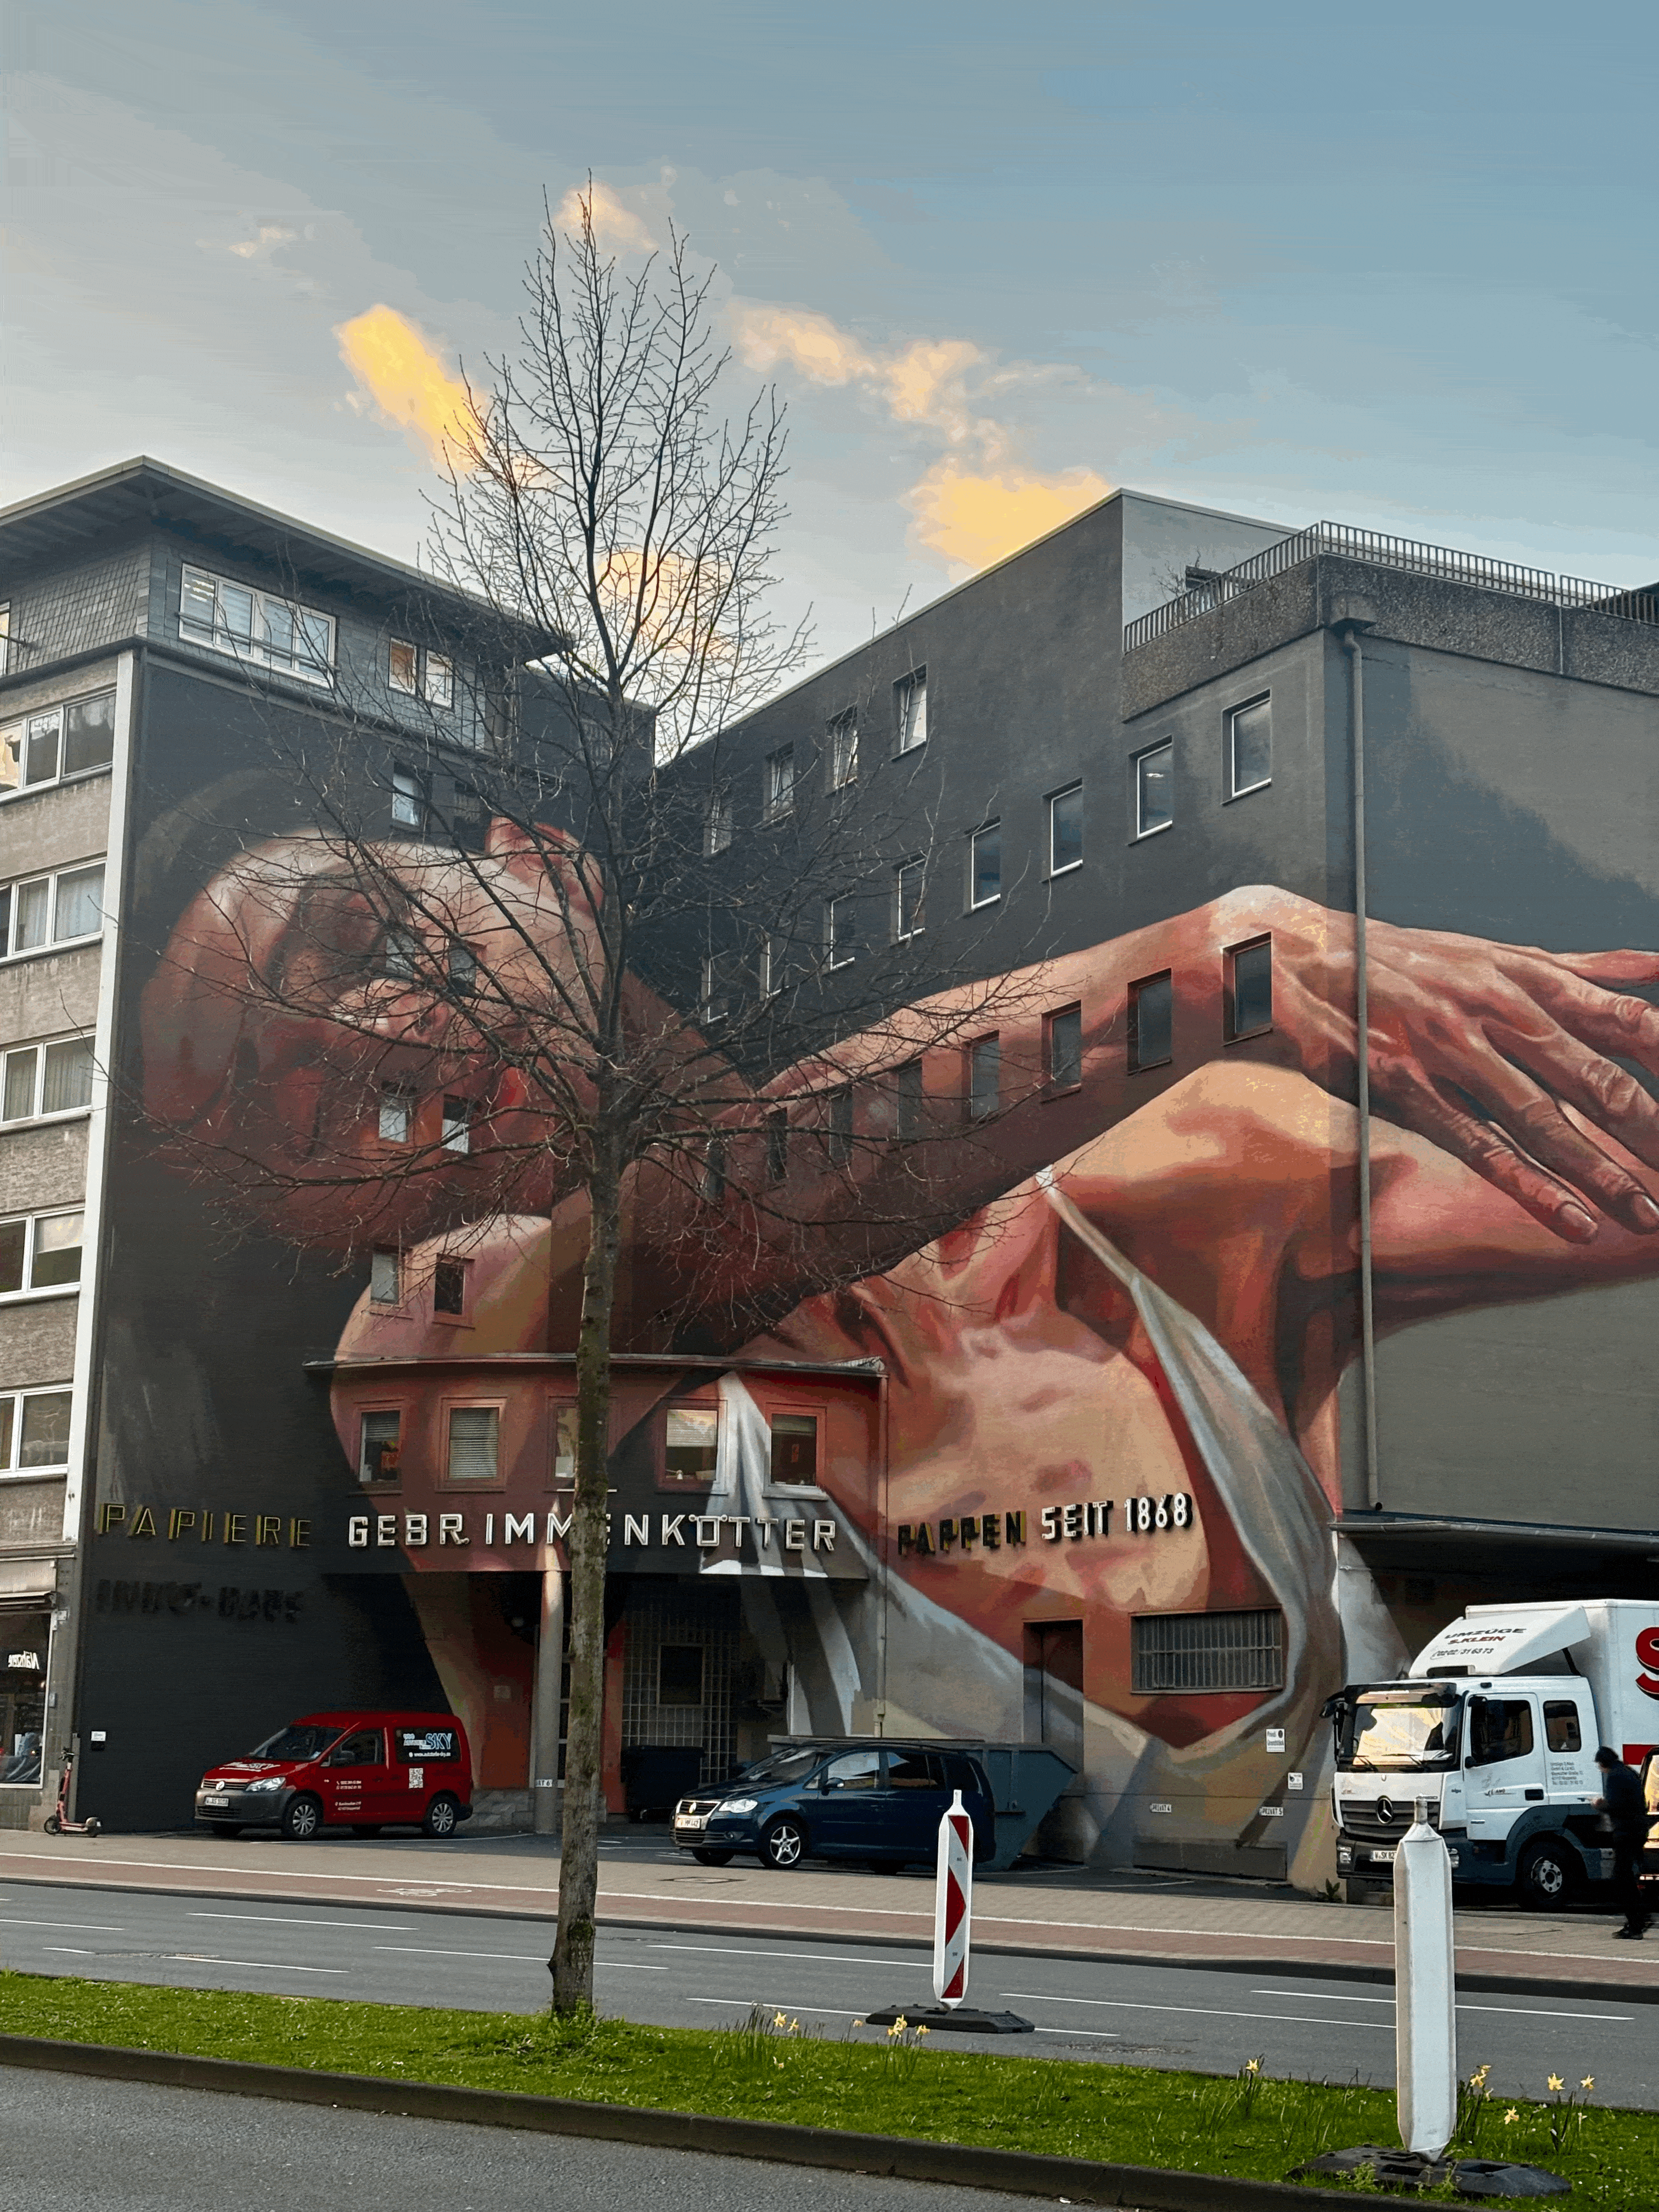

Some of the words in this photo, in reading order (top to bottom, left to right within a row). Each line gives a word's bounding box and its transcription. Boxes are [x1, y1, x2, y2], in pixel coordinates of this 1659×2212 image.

[97, 1503, 312, 1548] PAPIERE
[485, 1512, 836, 1552] IMMNKÖTTER
[897, 1510, 1028, 1556] PAPPEN
[1041, 1500, 1114, 1541] SEIT
[1123, 1492, 1192, 1533] 1868
[1444, 1628, 1527, 1639] UMZÜGE
[425, 1733, 453, 1750] SKY
